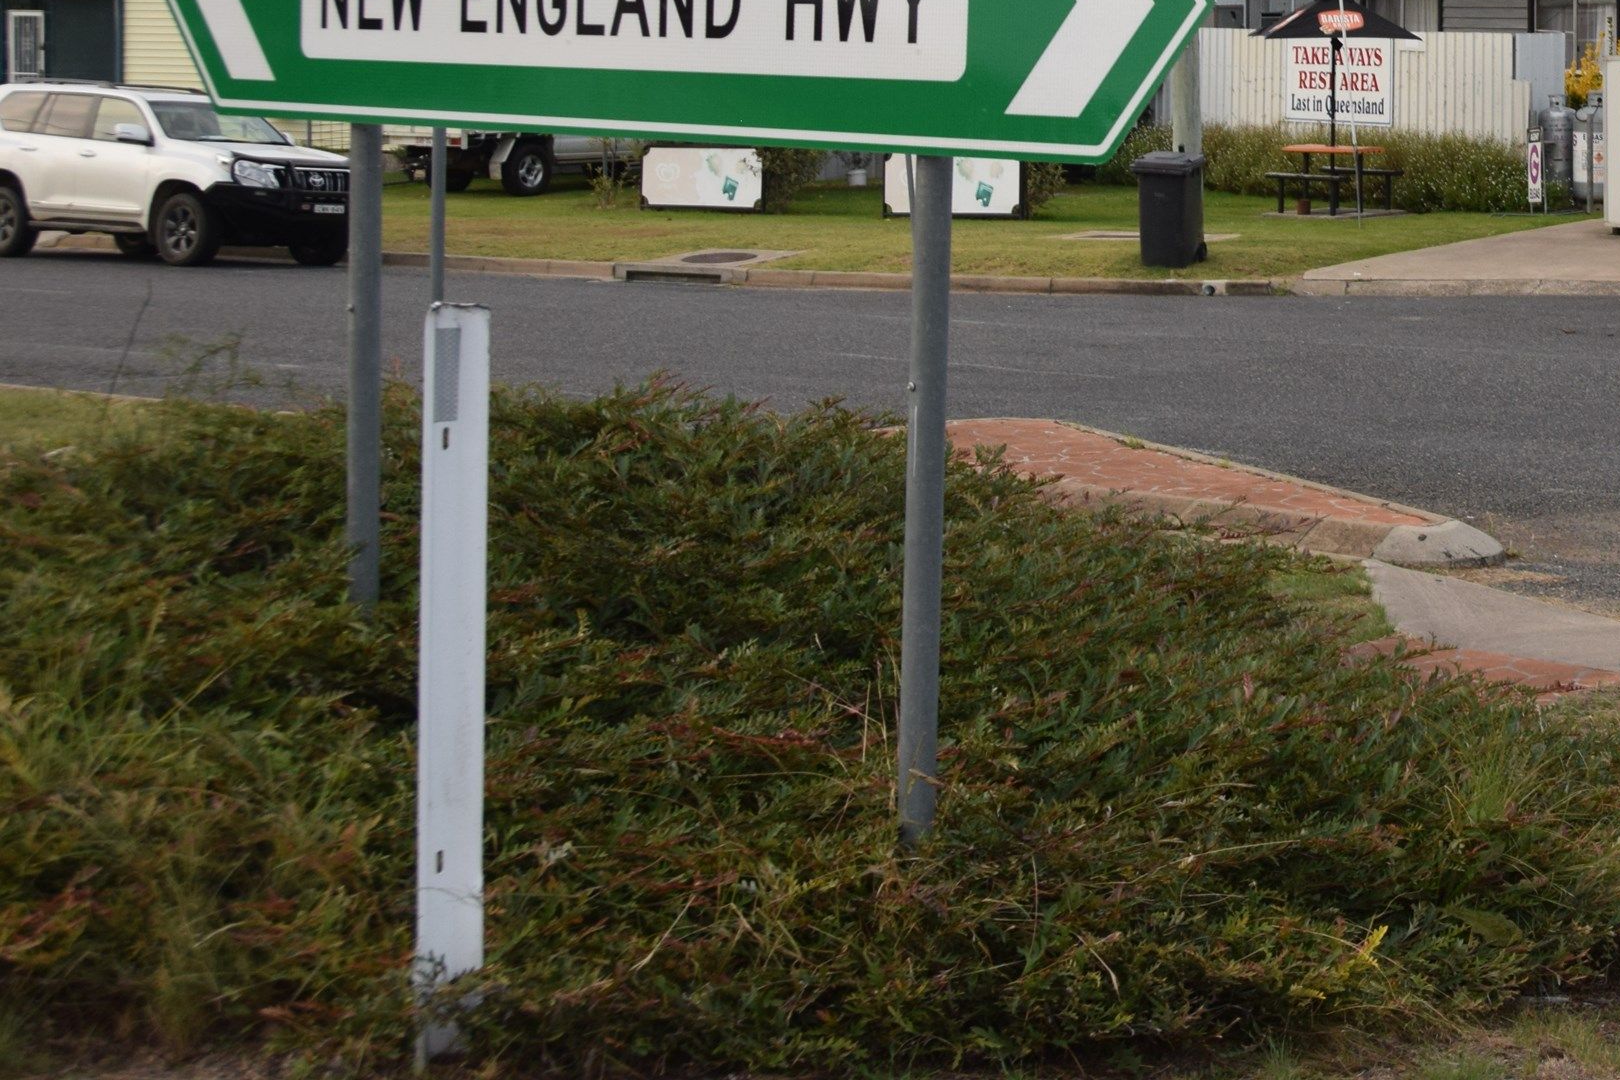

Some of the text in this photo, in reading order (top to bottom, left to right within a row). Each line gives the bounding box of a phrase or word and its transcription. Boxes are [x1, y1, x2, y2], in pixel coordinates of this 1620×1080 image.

[1292, 46, 1330, 65] TAKE
[1298, 71, 1380, 91] REST AREA
[1291, 93, 1310, 111] Last
[1312, 95, 1322, 112] in
